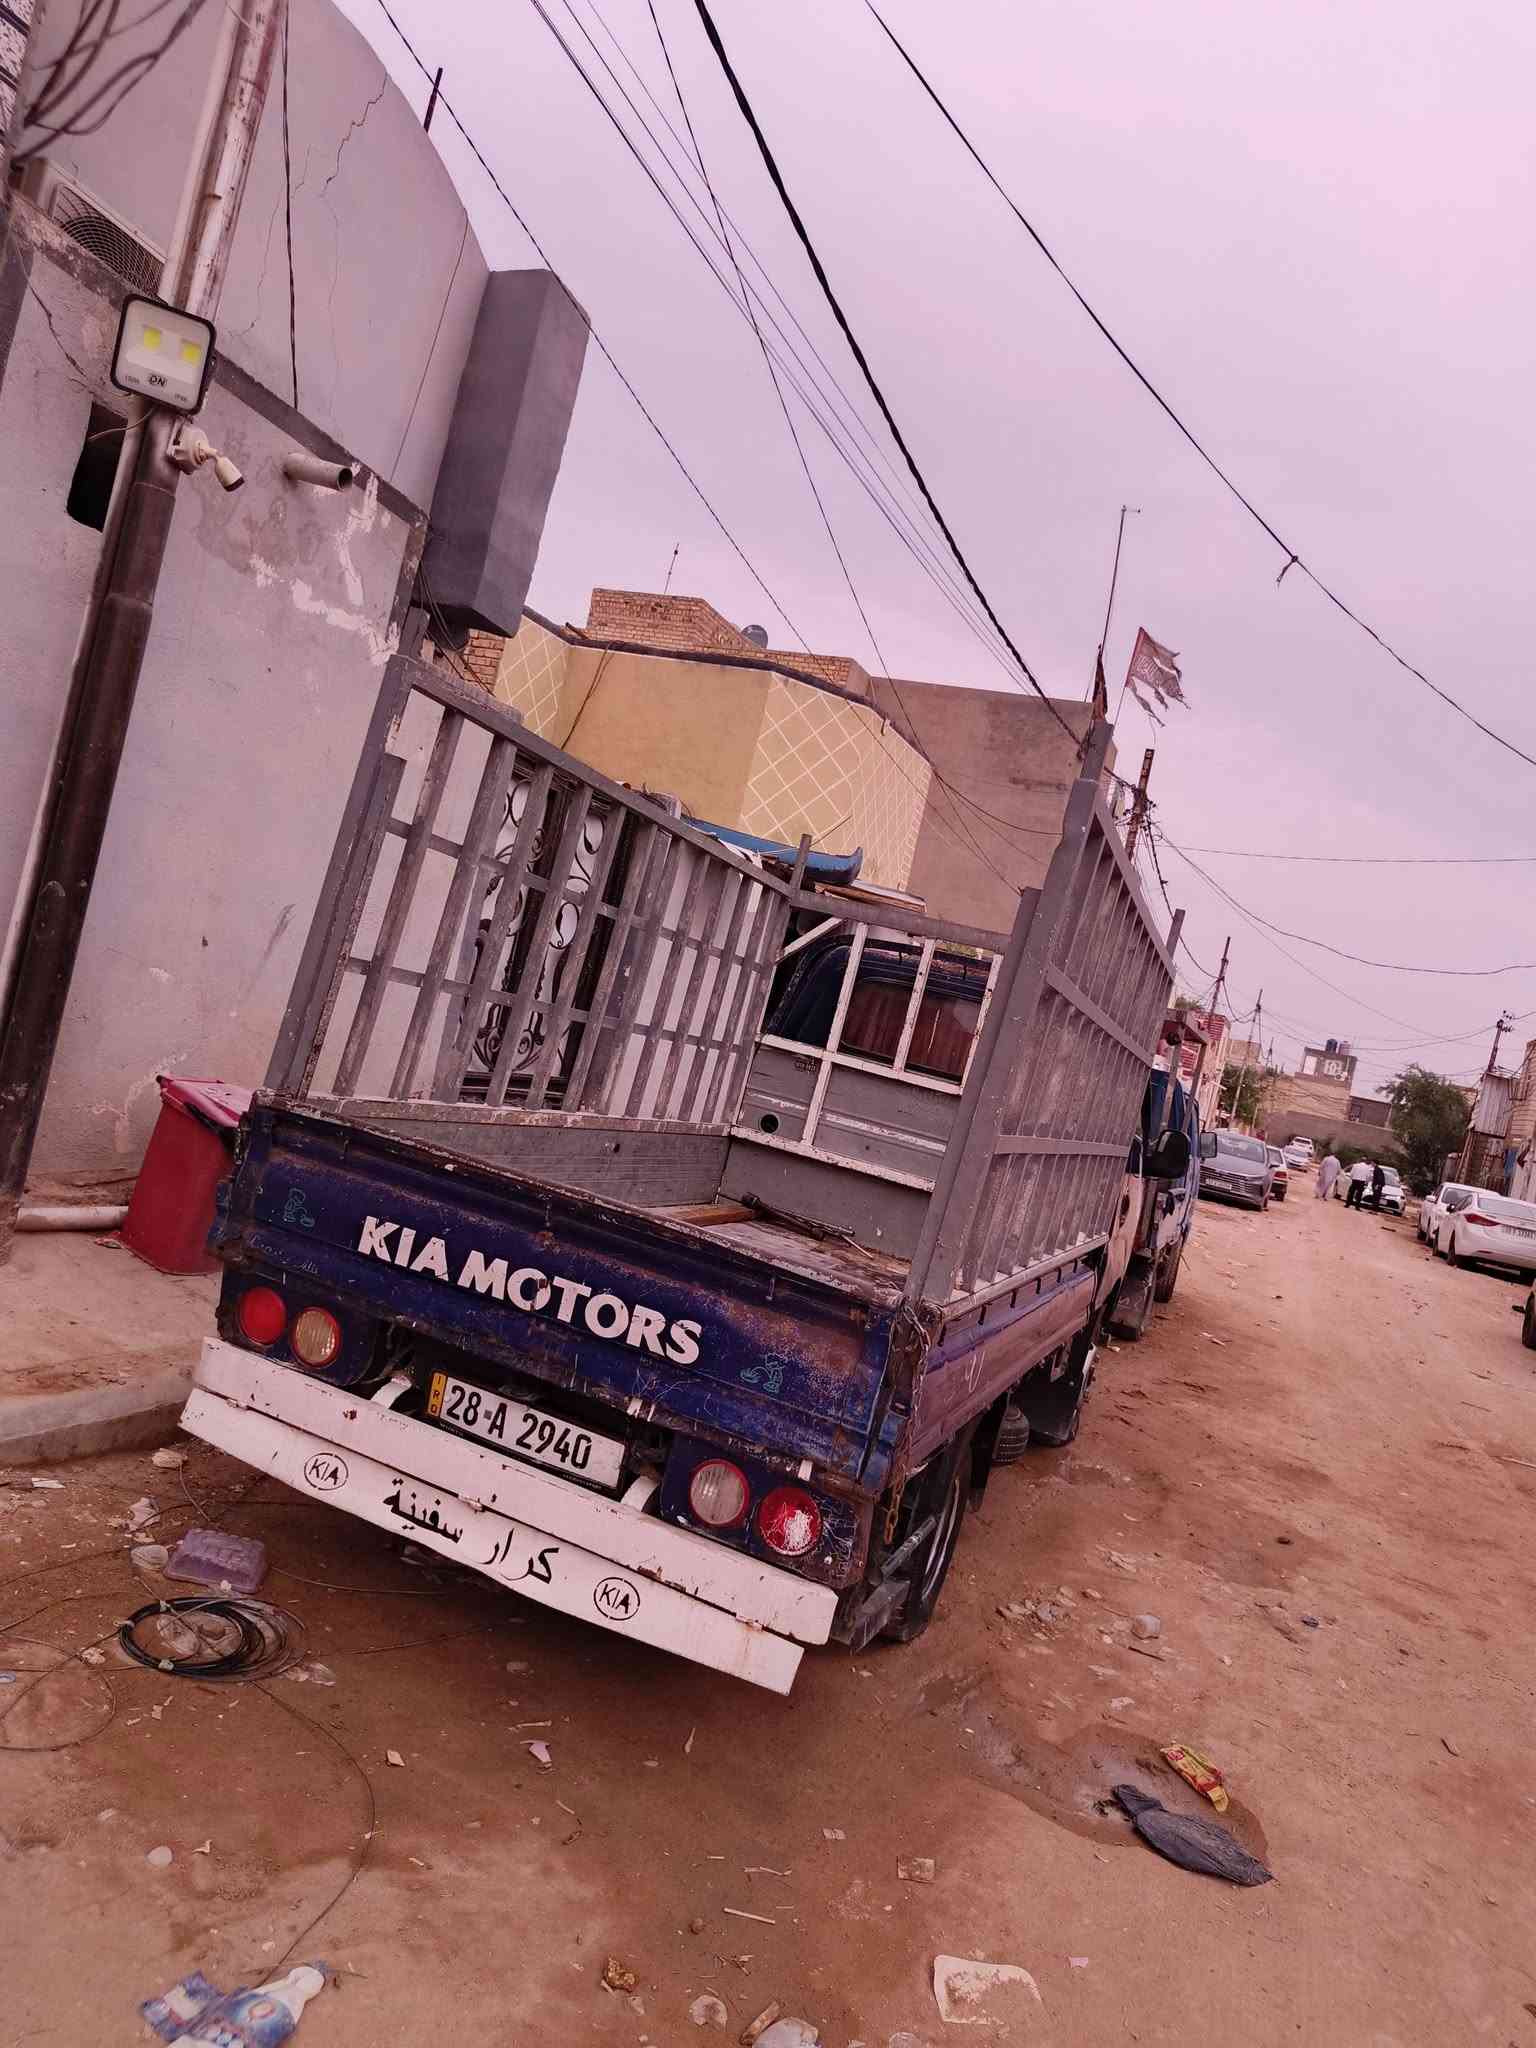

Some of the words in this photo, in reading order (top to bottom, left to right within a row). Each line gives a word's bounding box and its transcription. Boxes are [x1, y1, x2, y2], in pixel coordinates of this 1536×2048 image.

[357, 1215, 449, 1282] KIA
[456, 1250, 702, 1365] MOTORS
[515, 1412, 593, 1470] 2940
[307, 1457, 341, 1487] KIA
[382, 1477, 464, 1545] سفينة
[597, 1582, 632, 1616] KIA
